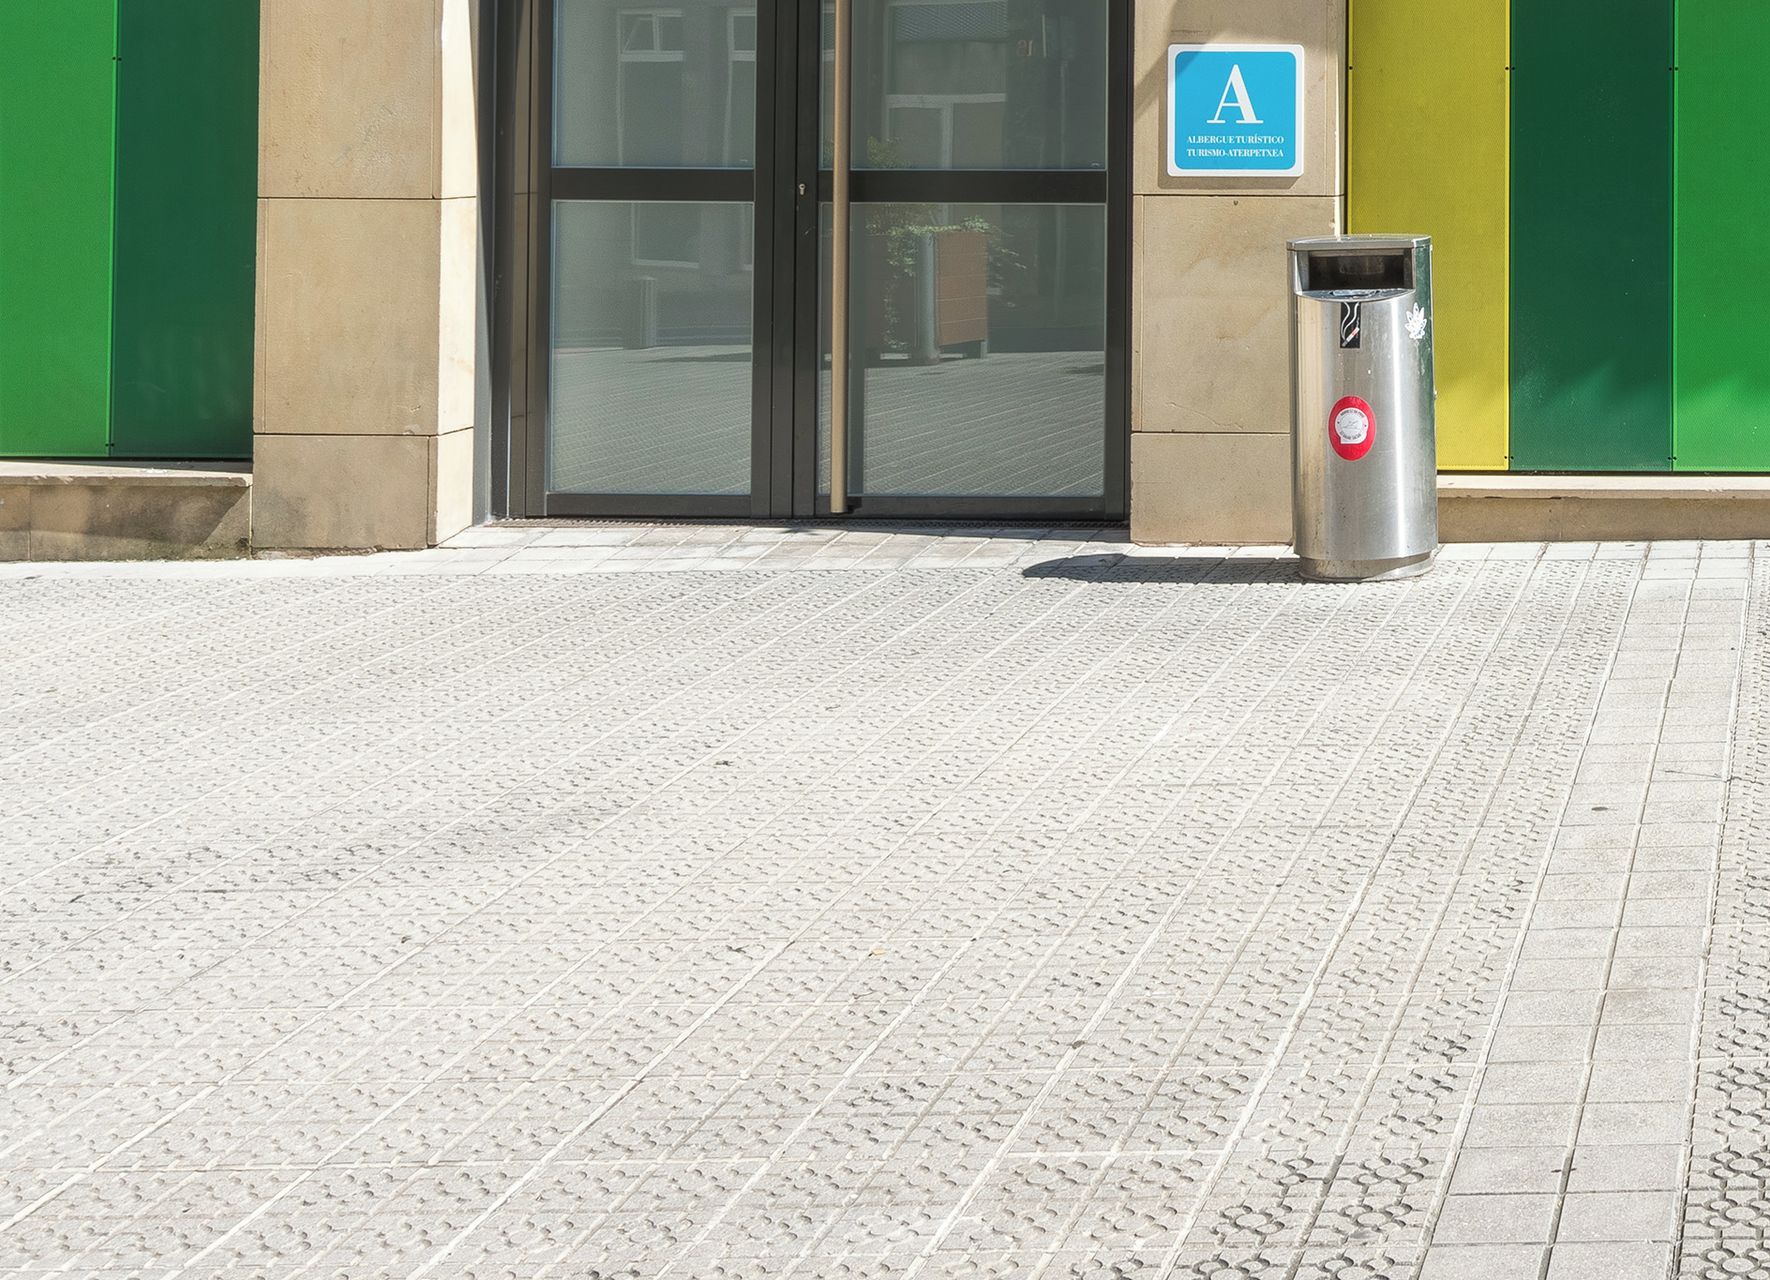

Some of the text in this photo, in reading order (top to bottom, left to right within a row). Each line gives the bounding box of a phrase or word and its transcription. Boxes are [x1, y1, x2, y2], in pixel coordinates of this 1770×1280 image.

[1206, 63, 1264, 124] A
[1186, 133, 1285, 144] ALBERGUE TURÍSTICO
[1186, 148, 1284, 158] TURISMO-ATERPETXEA
